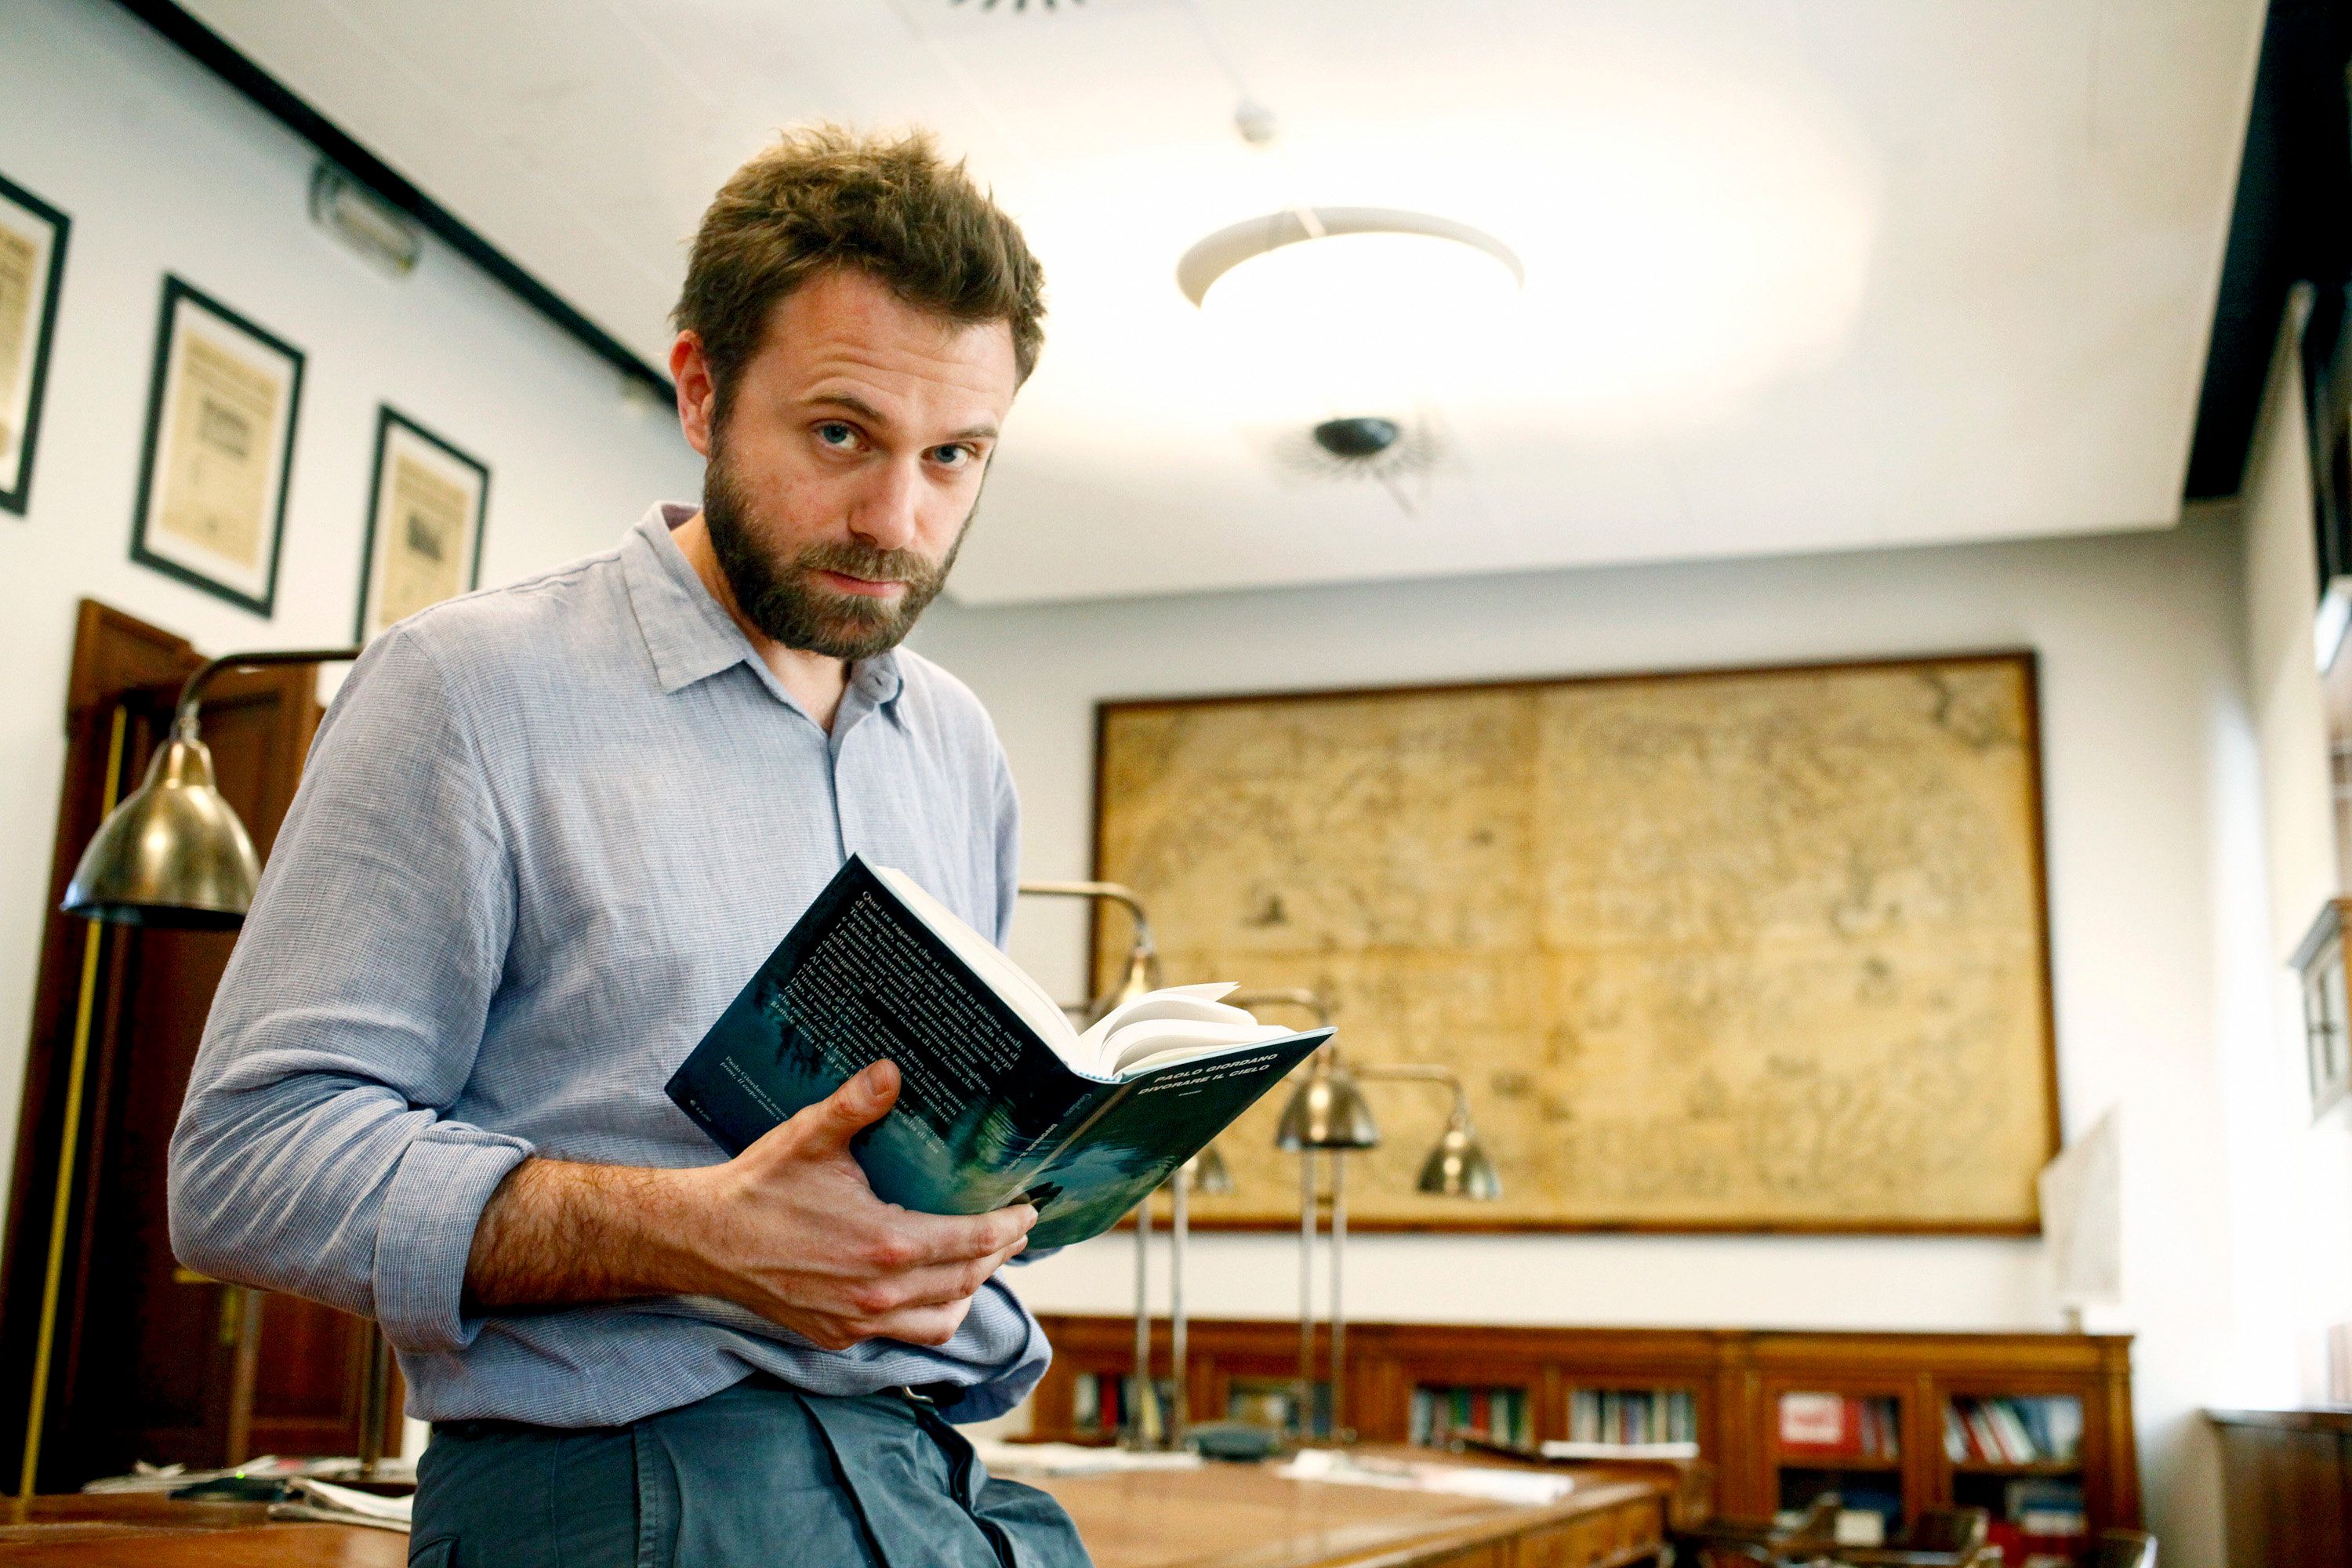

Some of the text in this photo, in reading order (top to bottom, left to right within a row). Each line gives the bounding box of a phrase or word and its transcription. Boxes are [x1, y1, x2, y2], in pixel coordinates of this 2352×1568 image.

[815, 946, 823, 954] li
[821, 953, 843, 975] tenga
[827, 931, 848, 950] nella
[845, 948, 877, 980] masseria
[839, 928, 871, 960] prossimi
[869, 957, 906, 993] vent'anni
[904, 990, 912, 1000] li
[909, 998, 950, 1038] passeranno
[949, 1035, 978, 1065] insieme
[846, 920, 877, 951] desideri
[875, 948, 920, 993] incontrollati
[942, 1014, 971, 1045] proprio
[970, 1042, 990, 1063] come
[854, 898, 866, 909] di
[895, 940, 925, 970] entrano
[924, 967, 945, 989] come
[944, 987, 956, 1000] un
[955, 997, 977, 1021] vento
[976, 1017, 996, 1038] nella
[994, 1035, 1011, 1053] vita
[1009, 1049, 1020, 1062] di
[860, 890, 882, 912] Quei
[880, 909, 893, 924] tre
[891, 920, 919, 949] ragazzi
[917, 945, 933, 962] che
[931, 959, 941, 969] si
[939, 966, 968, 996] tuffano
[966, 993, 977, 1004] in
[873, 931, 895, 954] Sono
[891, 952, 912, 973] poco
[924, 981, 939, 997] che
[970, 1026, 995, 1052] hanno
[992, 1049, 1014, 1072] corpi
[770, 1000, 796, 1025] grande
[794, 1022, 816, 1044] storia
[815, 1042, 824, 1052] in
[822, 1050, 836, 1064] cui
[782, 984, 815, 1015] Divorare
[812, 1012, 822, 1022] il
[818, 1018, 837, 1038] cielo
[836, 1035, 843, 1044] è
[841, 1042, 852, 1053] un
[795, 968, 833, 1006] l'intensità
[830, 1002, 841, 1014] di
[839, 1011, 853, 1025] chi
[851, 1023, 880, 1052] conosce
[801, 960, 817, 977] che
[815, 974, 837, 996] attira
[834, 993, 847, 1007] gli
[845, 1003, 863, 1021] altri
[866, 1023, 875, 1033] li
[872, 1031, 898, 1056] spinge
[895, 1052, 915, 1073] oltre
[913, 1069, 921, 1079] il
[942, 1101, 957, 1116] con
[806, 993, 815, 1001] il
[833, 1018, 843, 1029] la
[808, 953, 820, 966] Al
[818, 964, 843, 988] centro
[841, 985, 852, 996] di
[851, 995, 869, 1014] tutto
[868, 1011, 882, 1026] c'è
[880, 1025, 906, 1051] sempre
[925, 1069, 937, 1082] un
[935, 1080, 967, 1112] magnete
[862, 978, 878, 994] alla
[876, 993, 898, 1015] pazza
[896, 1013, 922, 1038] ricerca
[920, 1035, 931, 1047] di
[930, 1045, 941, 1057] un
[940, 1054, 963, 1078] fuoco
[960, 1075, 976, 1091] che
[776, 991, 792, 1007] che
[789, 1005, 826, 1040] restituisce
[826, 1038, 834, 1047] al
[833, 1046, 858, 1070] lettore
[916, 1129, 926, 1140] di
[924, 1139, 938, 1153] una
[1138, 1076, 1211, 1095] DIVORARE
[1229, 1065, 1270, 1077] CIELO
[1154, 1054, 1278, 1083] PAOLO GIORDANO
